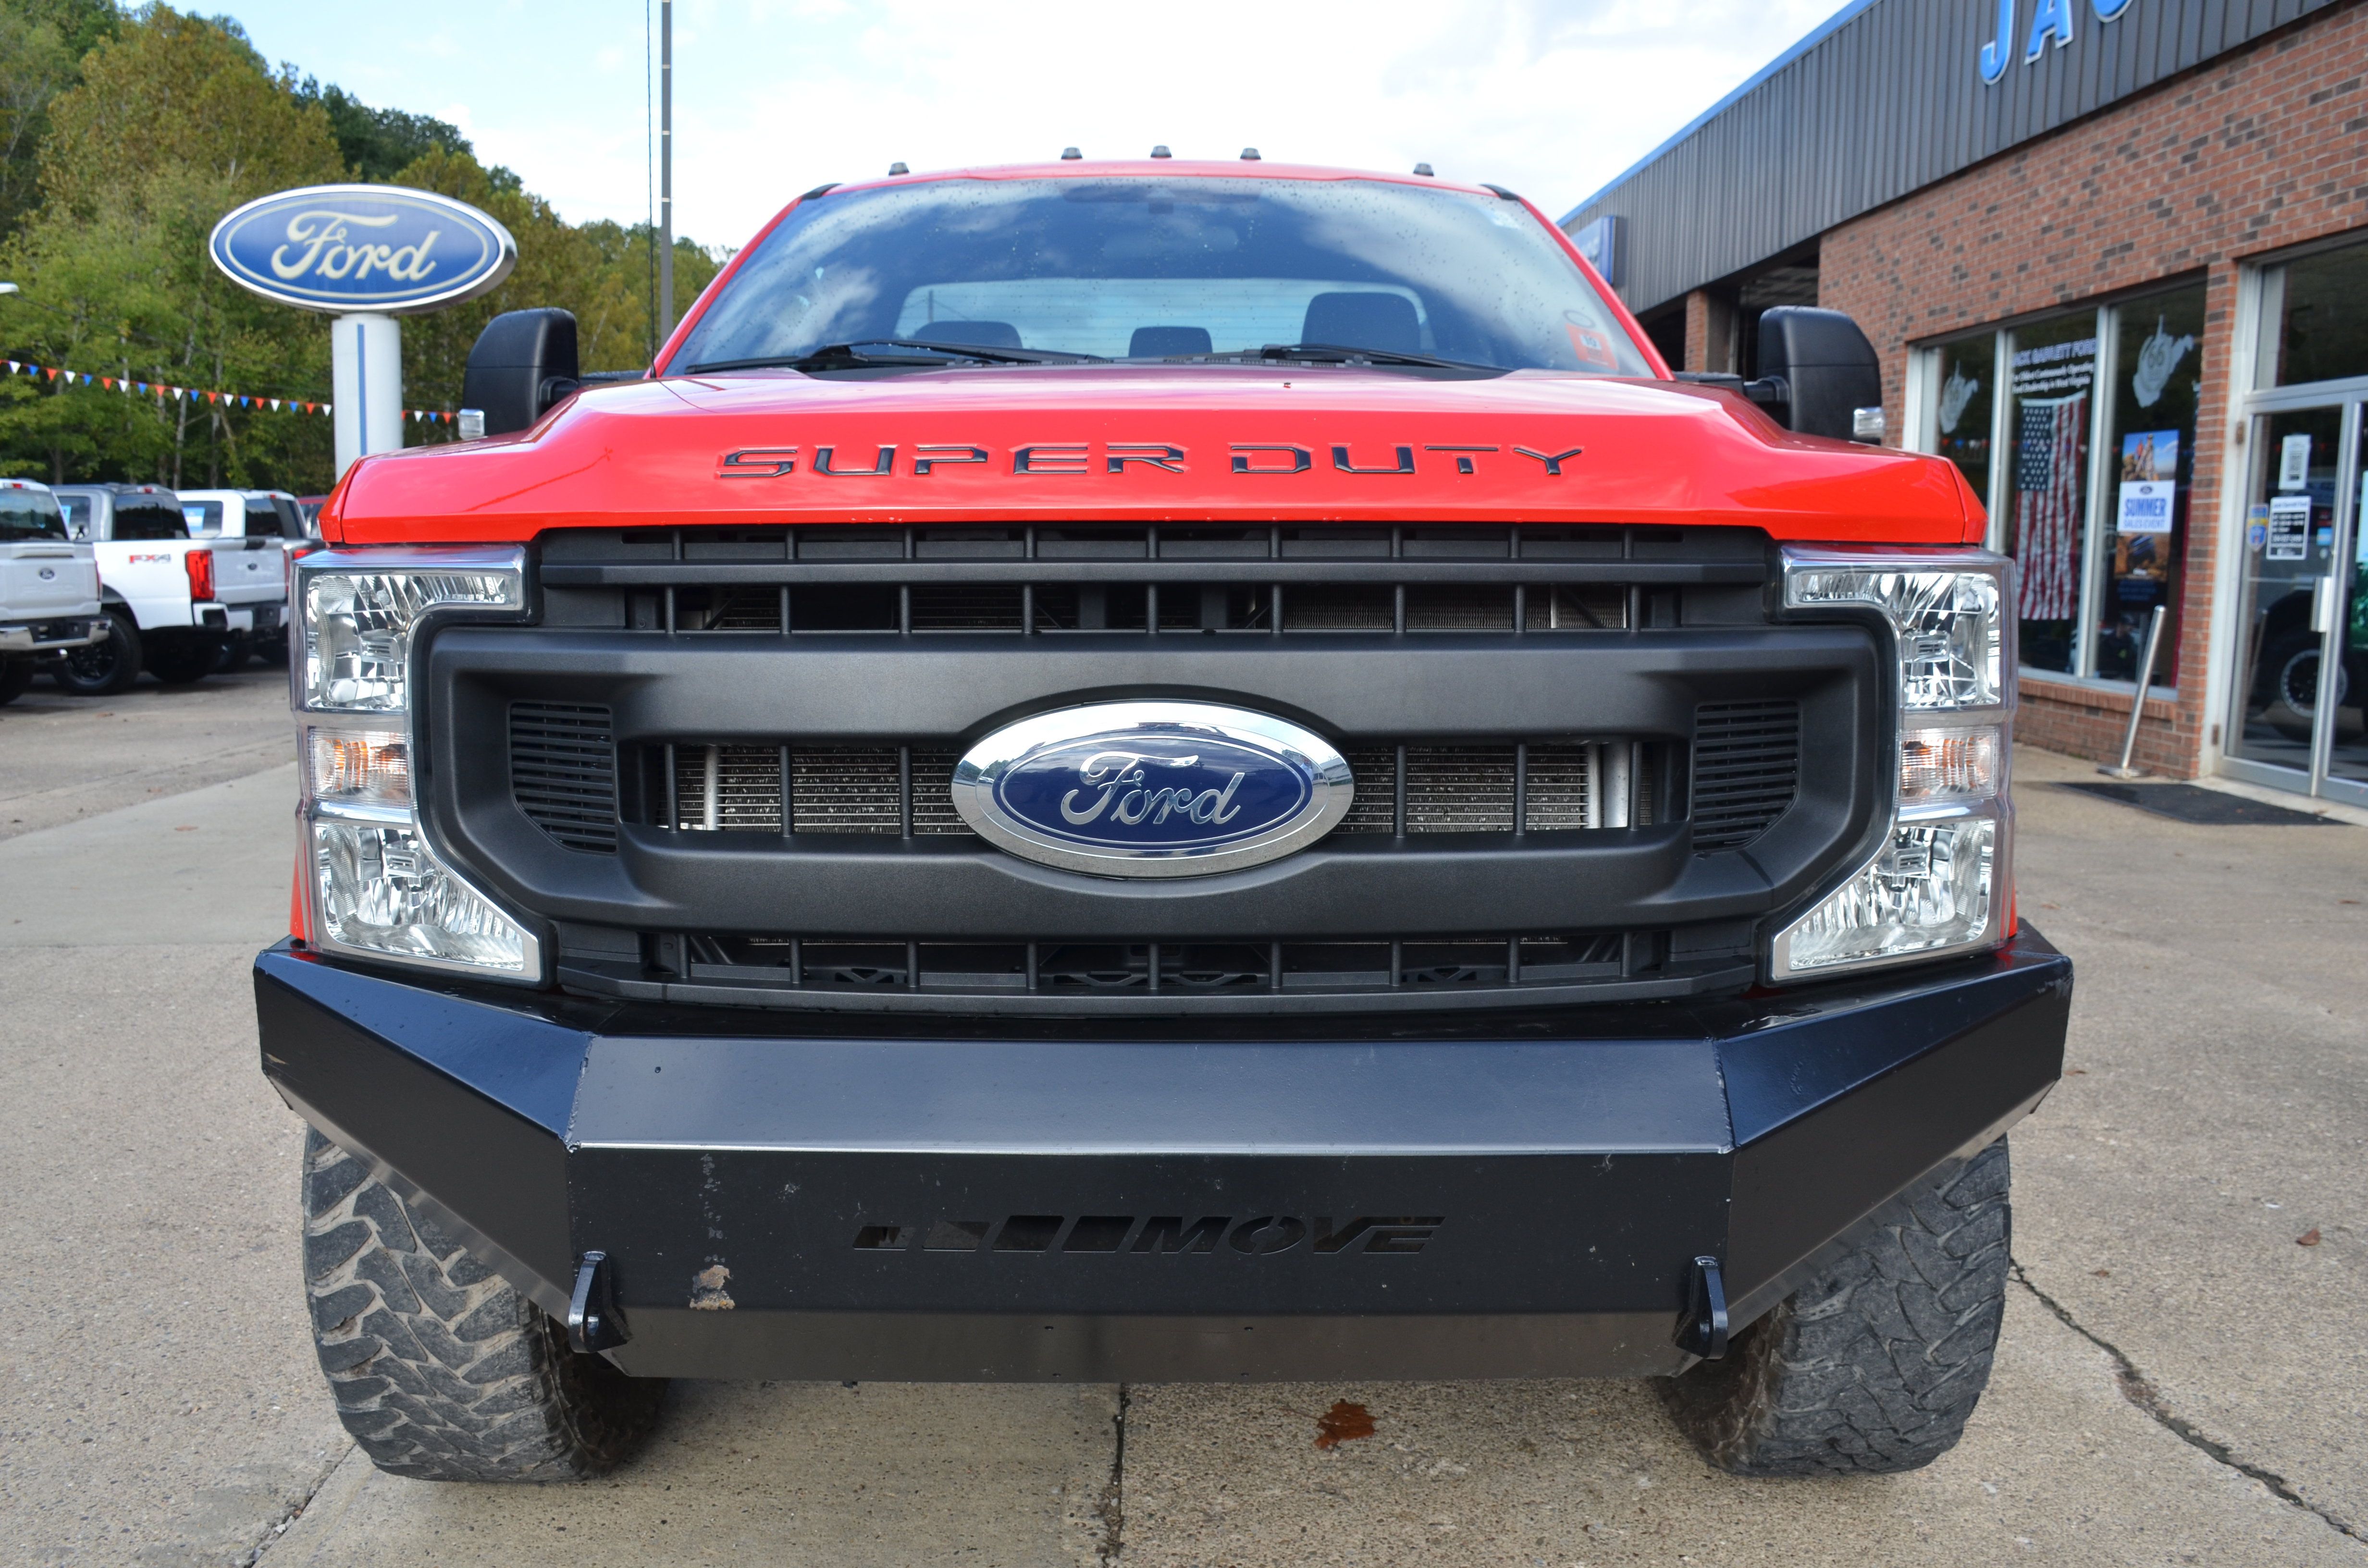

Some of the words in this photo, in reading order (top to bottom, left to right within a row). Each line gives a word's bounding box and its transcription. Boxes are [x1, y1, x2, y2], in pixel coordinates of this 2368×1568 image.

[271, 209, 441, 282] Ford
[718, 443, 1188, 478] SUPER
[1228, 443, 1583, 475] DUTY
[2124, 498, 2167, 517] SUMMER
[129, 554, 172, 564] FX4
[1060, 751, 1246, 825] Ford
[1129, 1215, 1446, 1255] MOVE
